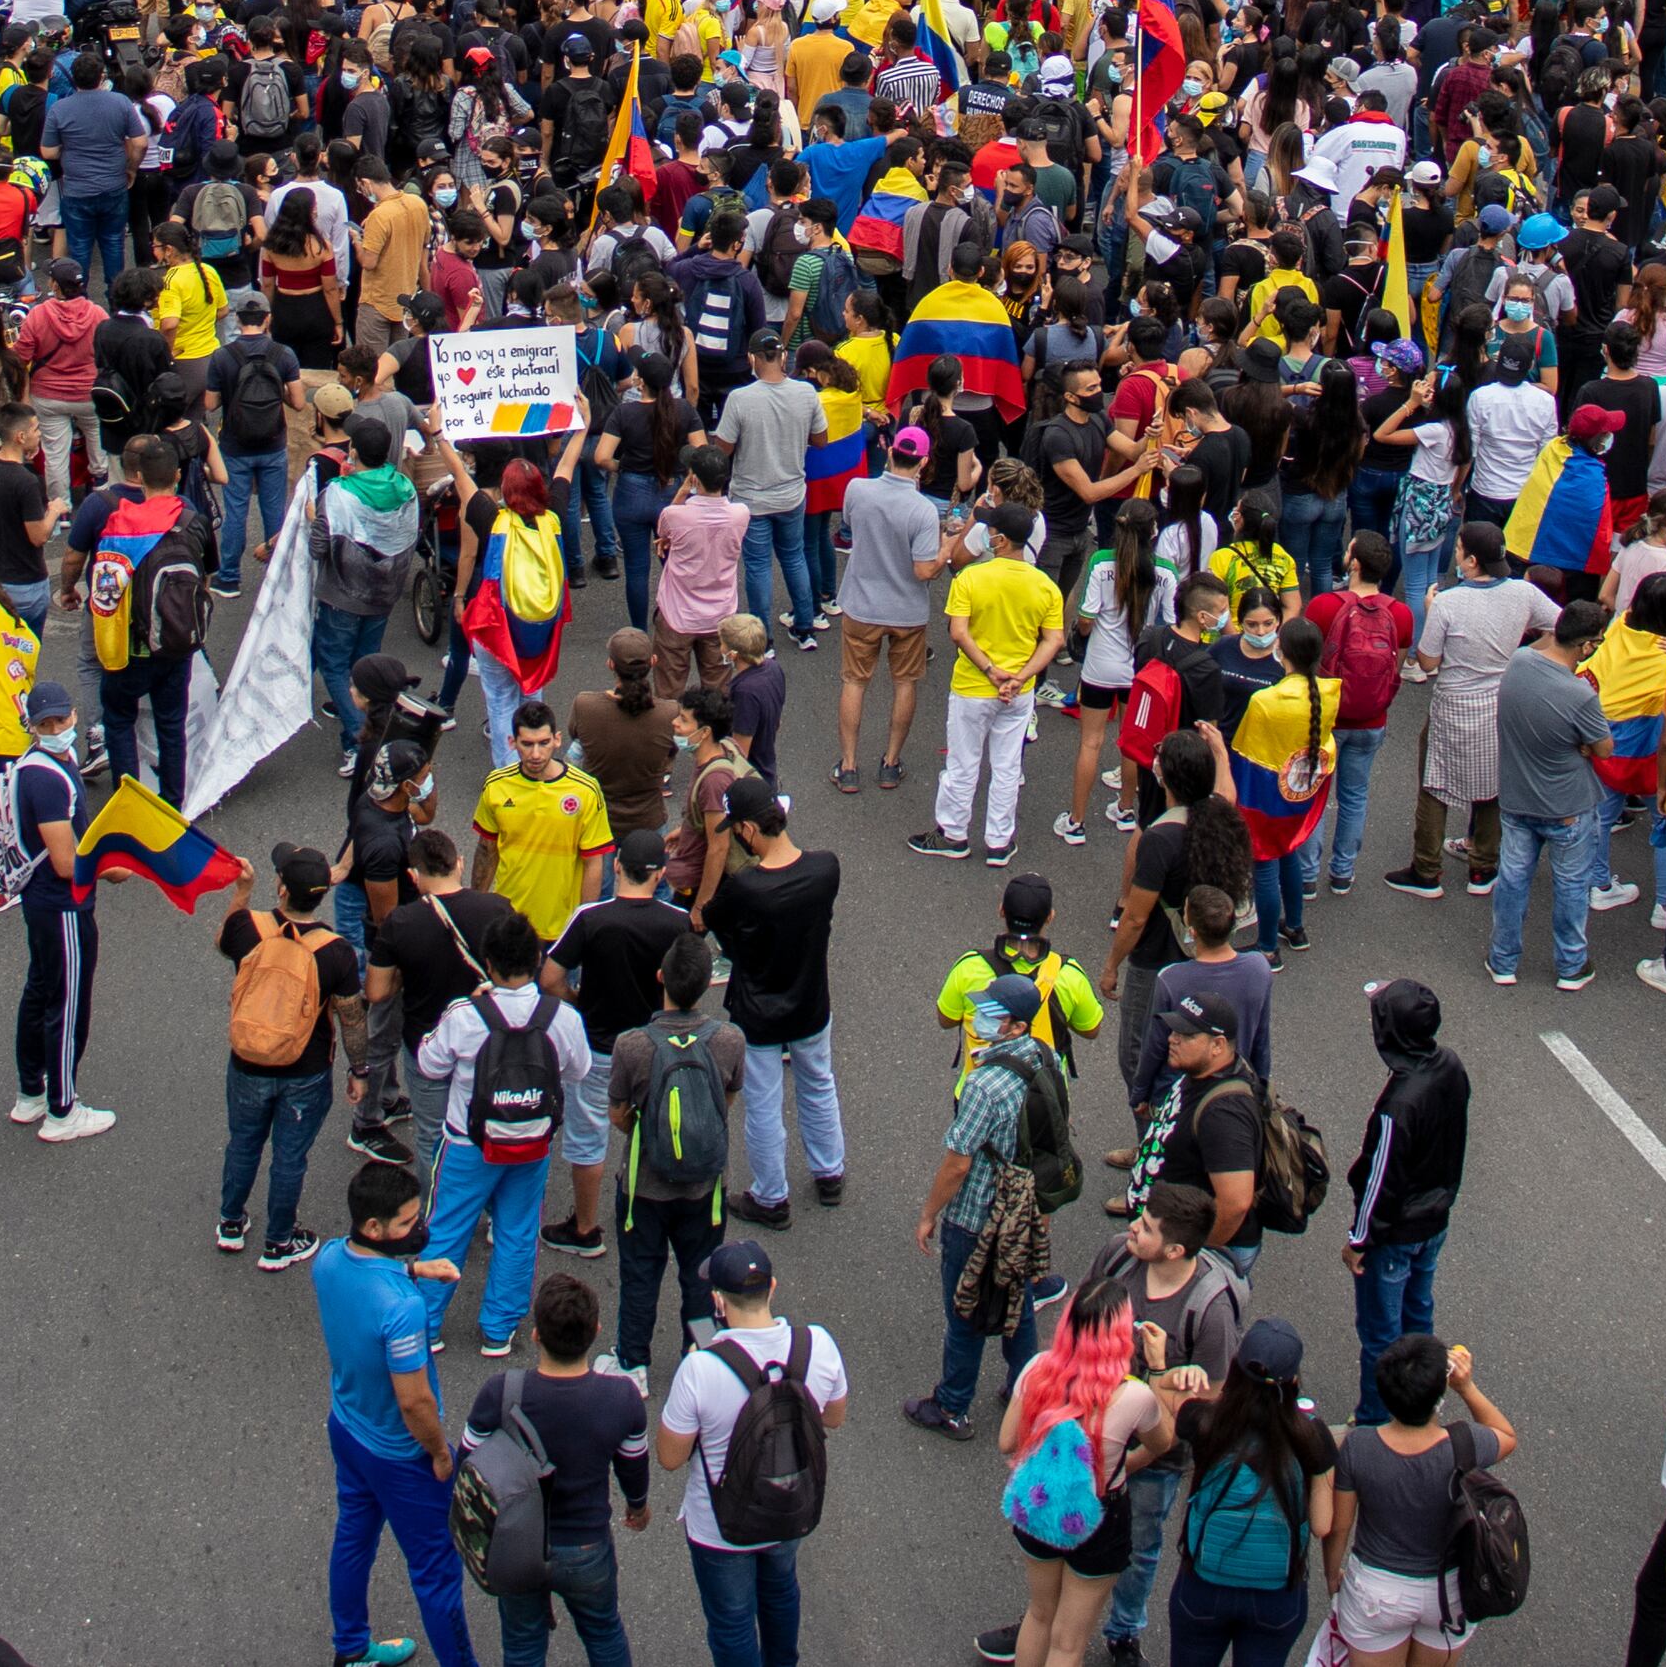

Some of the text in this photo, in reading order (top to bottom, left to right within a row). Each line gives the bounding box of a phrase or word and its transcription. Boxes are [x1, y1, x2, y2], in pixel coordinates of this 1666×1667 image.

[968, 90, 1006, 110] DERECHOS
[432, 338, 449, 363] Yo
[454, 349, 471, 362] no
[476, 348, 495, 364] voy
[497, 347, 506, 358] a
[437, 372, 451, 389] yo
[511, 361, 559, 380] platanal
[440, 385, 550, 409] y seguiré luchando
[445, 417, 464, 431] por
[494, 1088, 543, 1104] NikeAir
